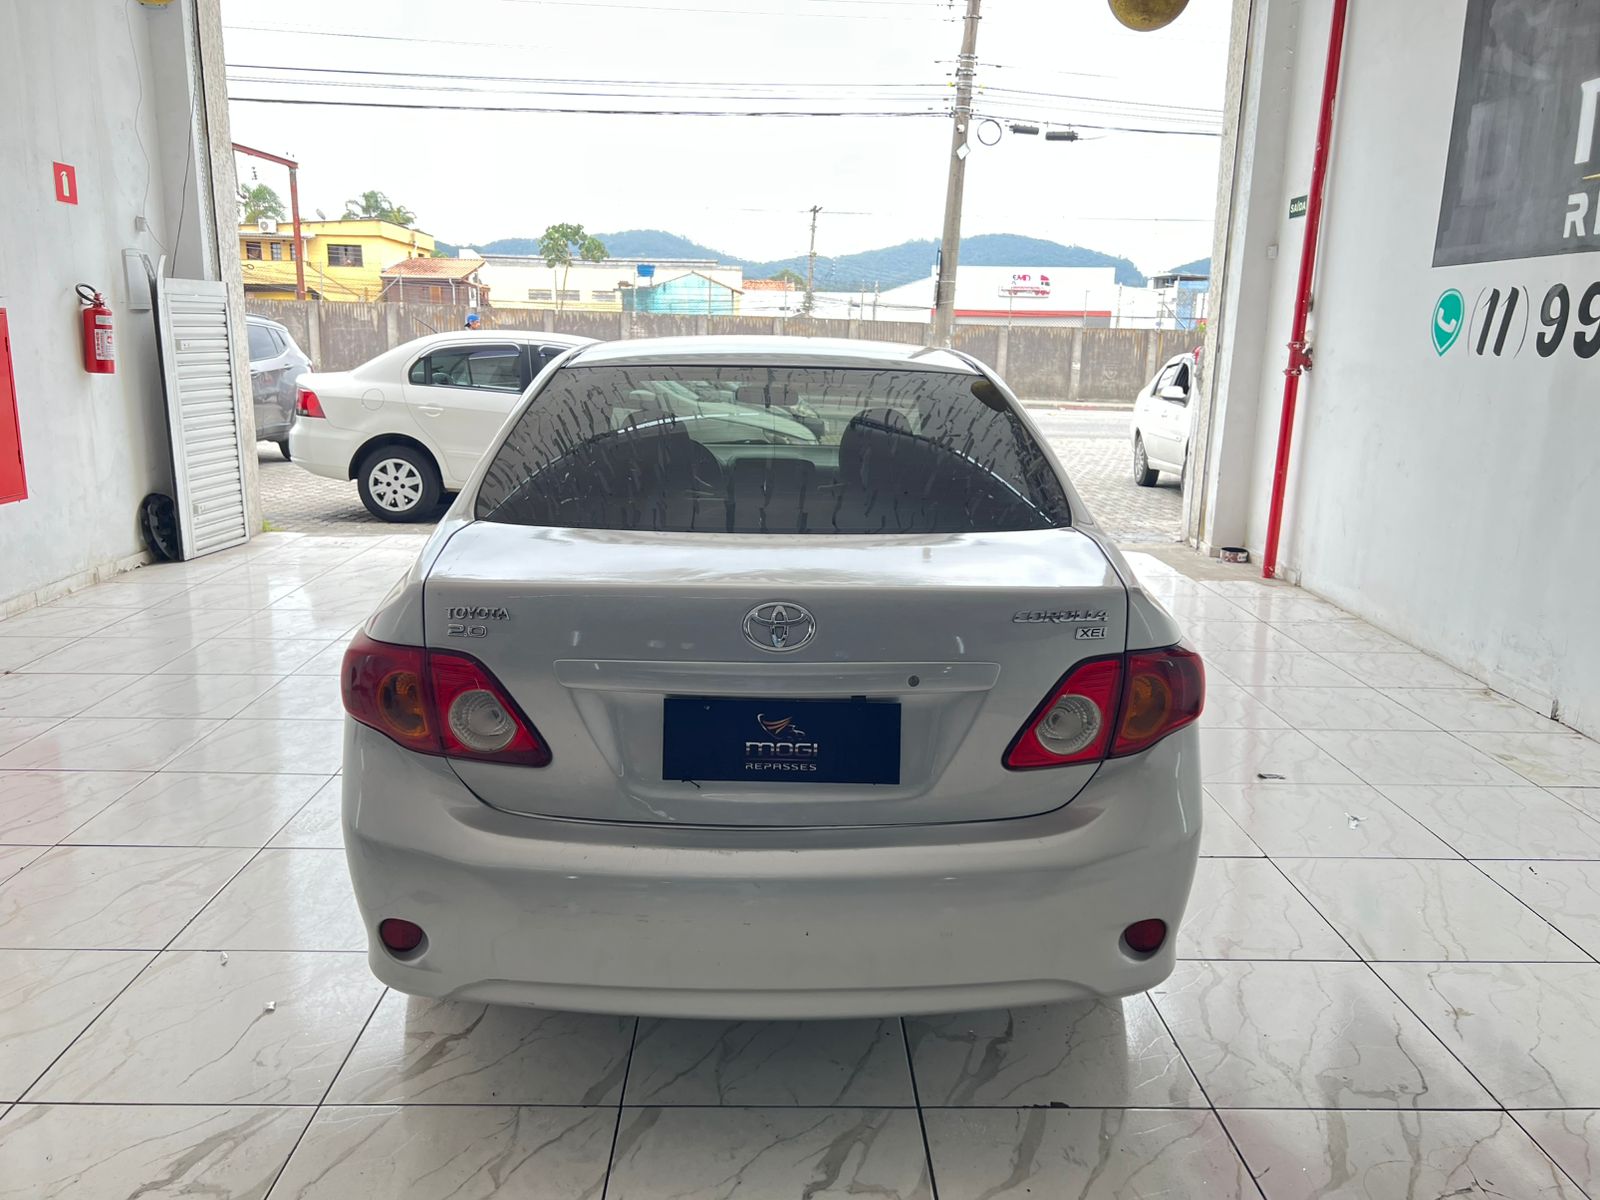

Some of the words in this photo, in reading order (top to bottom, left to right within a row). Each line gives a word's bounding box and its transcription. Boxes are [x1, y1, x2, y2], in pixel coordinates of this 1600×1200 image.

[1563, 190, 1600, 238] R
[1467, 285, 1529, 359] (11)
[1536, 281, 1600, 359] 99
[446, 606, 511, 620] TOYOTA
[1012, 610, 1107, 623] COROLLA
[447, 623, 487, 638] 2.0
[745, 742, 818, 756] MOGI
[745, 762, 817, 771] REPASSES
